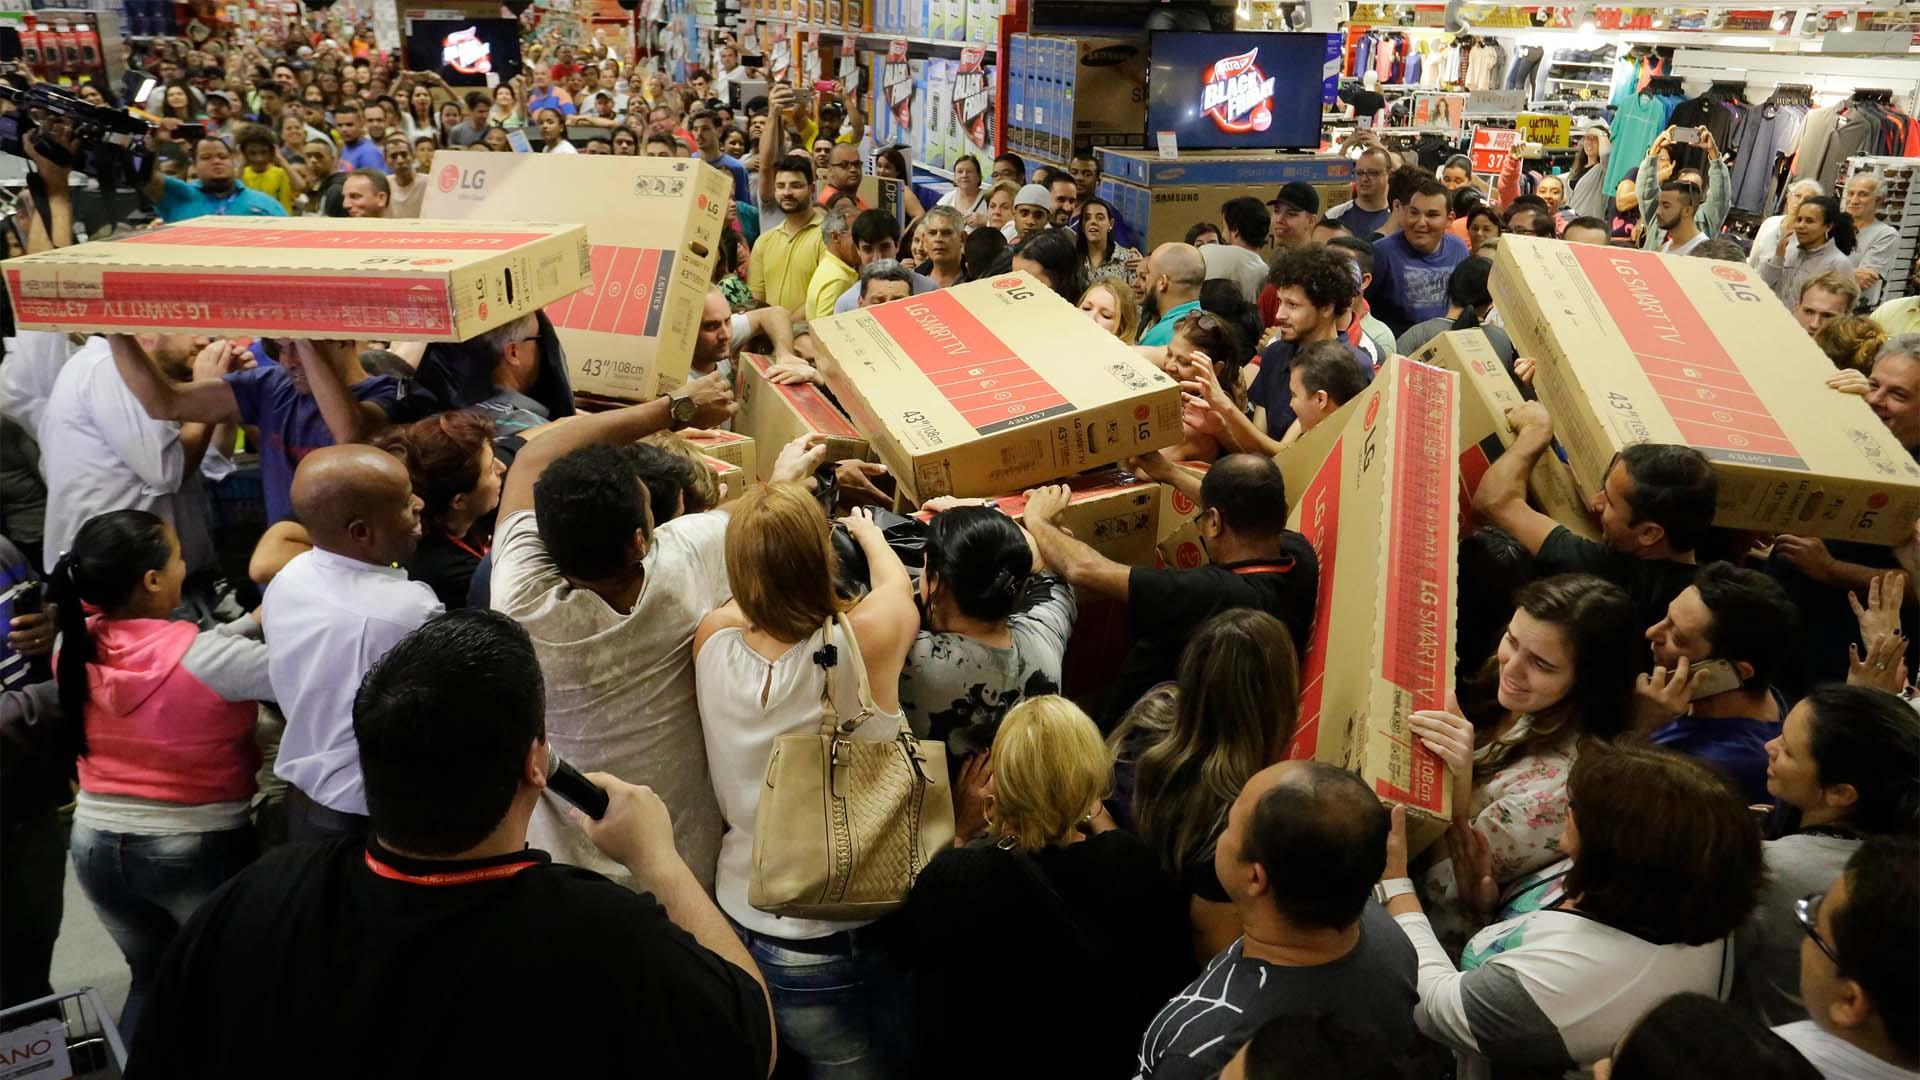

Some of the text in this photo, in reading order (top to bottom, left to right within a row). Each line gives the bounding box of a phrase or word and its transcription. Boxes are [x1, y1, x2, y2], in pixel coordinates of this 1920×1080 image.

[1203, 71, 1259, 110] BLACK
[1227, 77, 1275, 123] FRIDAY
[1527, 134, 1560, 145] CHANCE
[461, 168, 487, 190] LG
[885, 182, 897, 202] 40
[1155, 192, 1199, 202] SAMSUNG
[707, 200, 719, 215] LG
[1006, 286, 1035, 301] LG
[1609, 257, 1687, 345] LG SMART TV
[1728, 282, 1761, 303] LG
[132, 302, 184, 321] SMART
[904, 303, 972, 355] LG SMART TV
[1138, 421, 1151, 440] LG
[1363, 425, 1378, 473] LG
[1314, 484, 1328, 526] LG
[1858, 511, 1879, 529] LG
[1415, 579, 1440, 702] LG SMART TV
